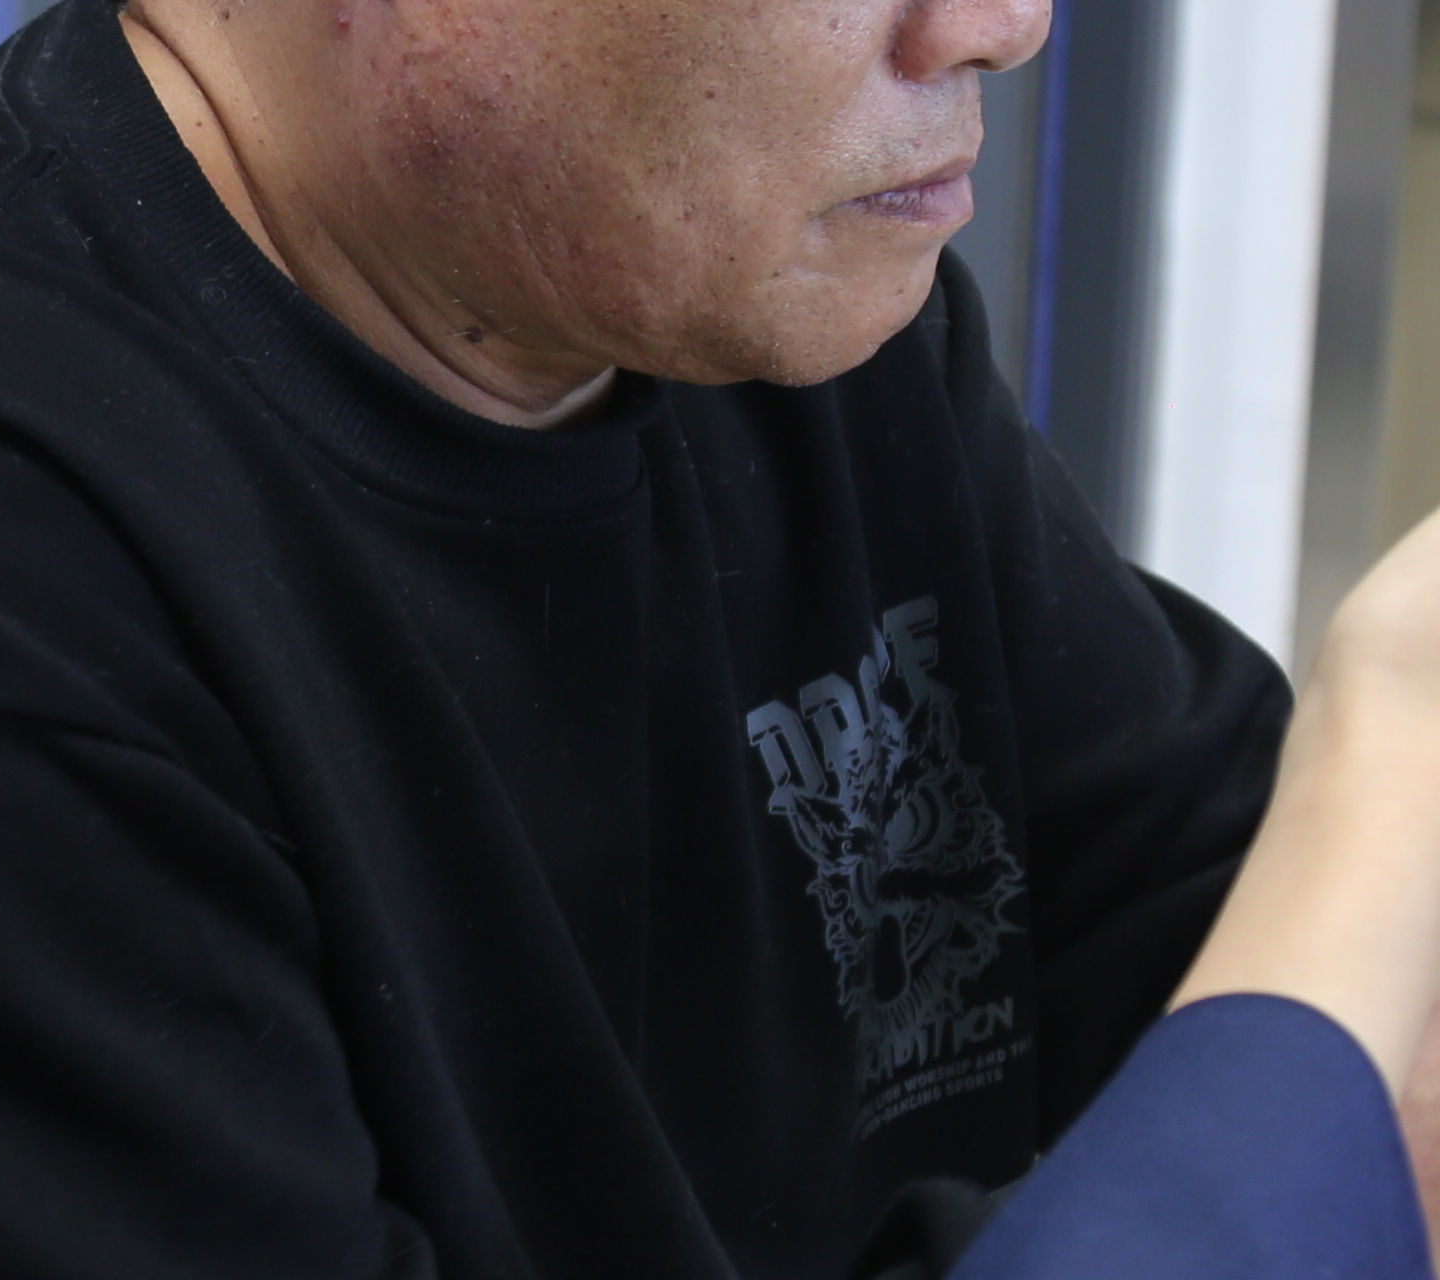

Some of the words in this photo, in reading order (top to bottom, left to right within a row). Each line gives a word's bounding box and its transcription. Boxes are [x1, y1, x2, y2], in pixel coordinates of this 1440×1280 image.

[903, 1057, 972, 1093] WORSHIP
[975, 1047, 1007, 1070] AND
[944, 1066, 1004, 1097] SPORTS
